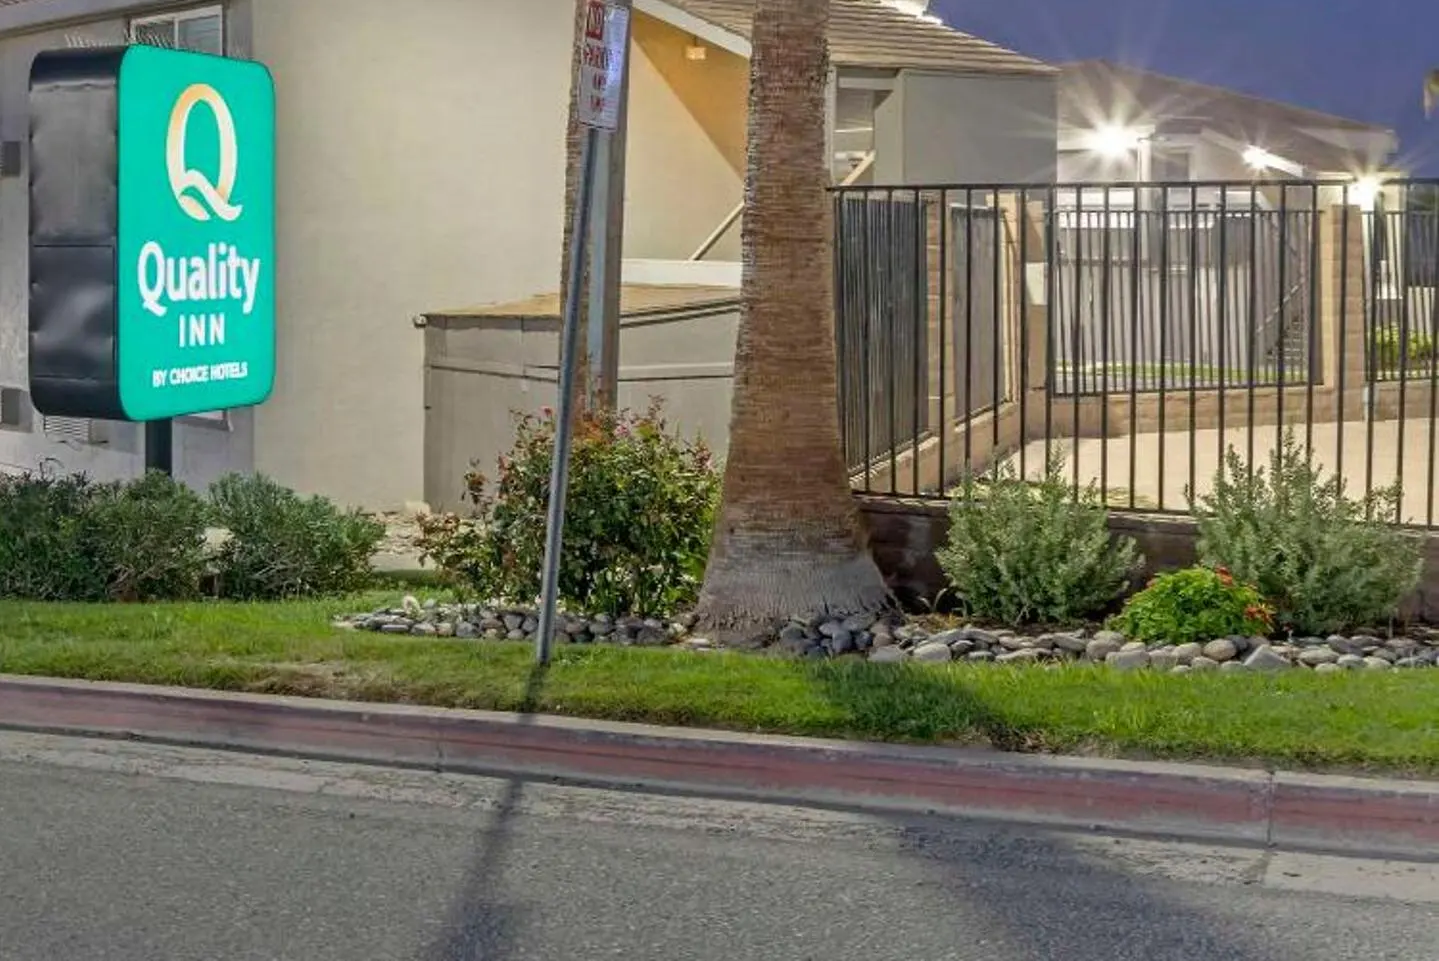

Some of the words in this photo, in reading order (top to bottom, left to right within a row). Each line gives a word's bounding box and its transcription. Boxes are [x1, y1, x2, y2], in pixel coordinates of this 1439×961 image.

[165, 83, 243, 221] Q
[137, 241, 260, 316] Quality
[179, 313, 226, 347] INN
[152, 369, 168, 387] BY
[169, 365, 209, 385] CHOICE
[210, 362, 248, 381] HOTELS
